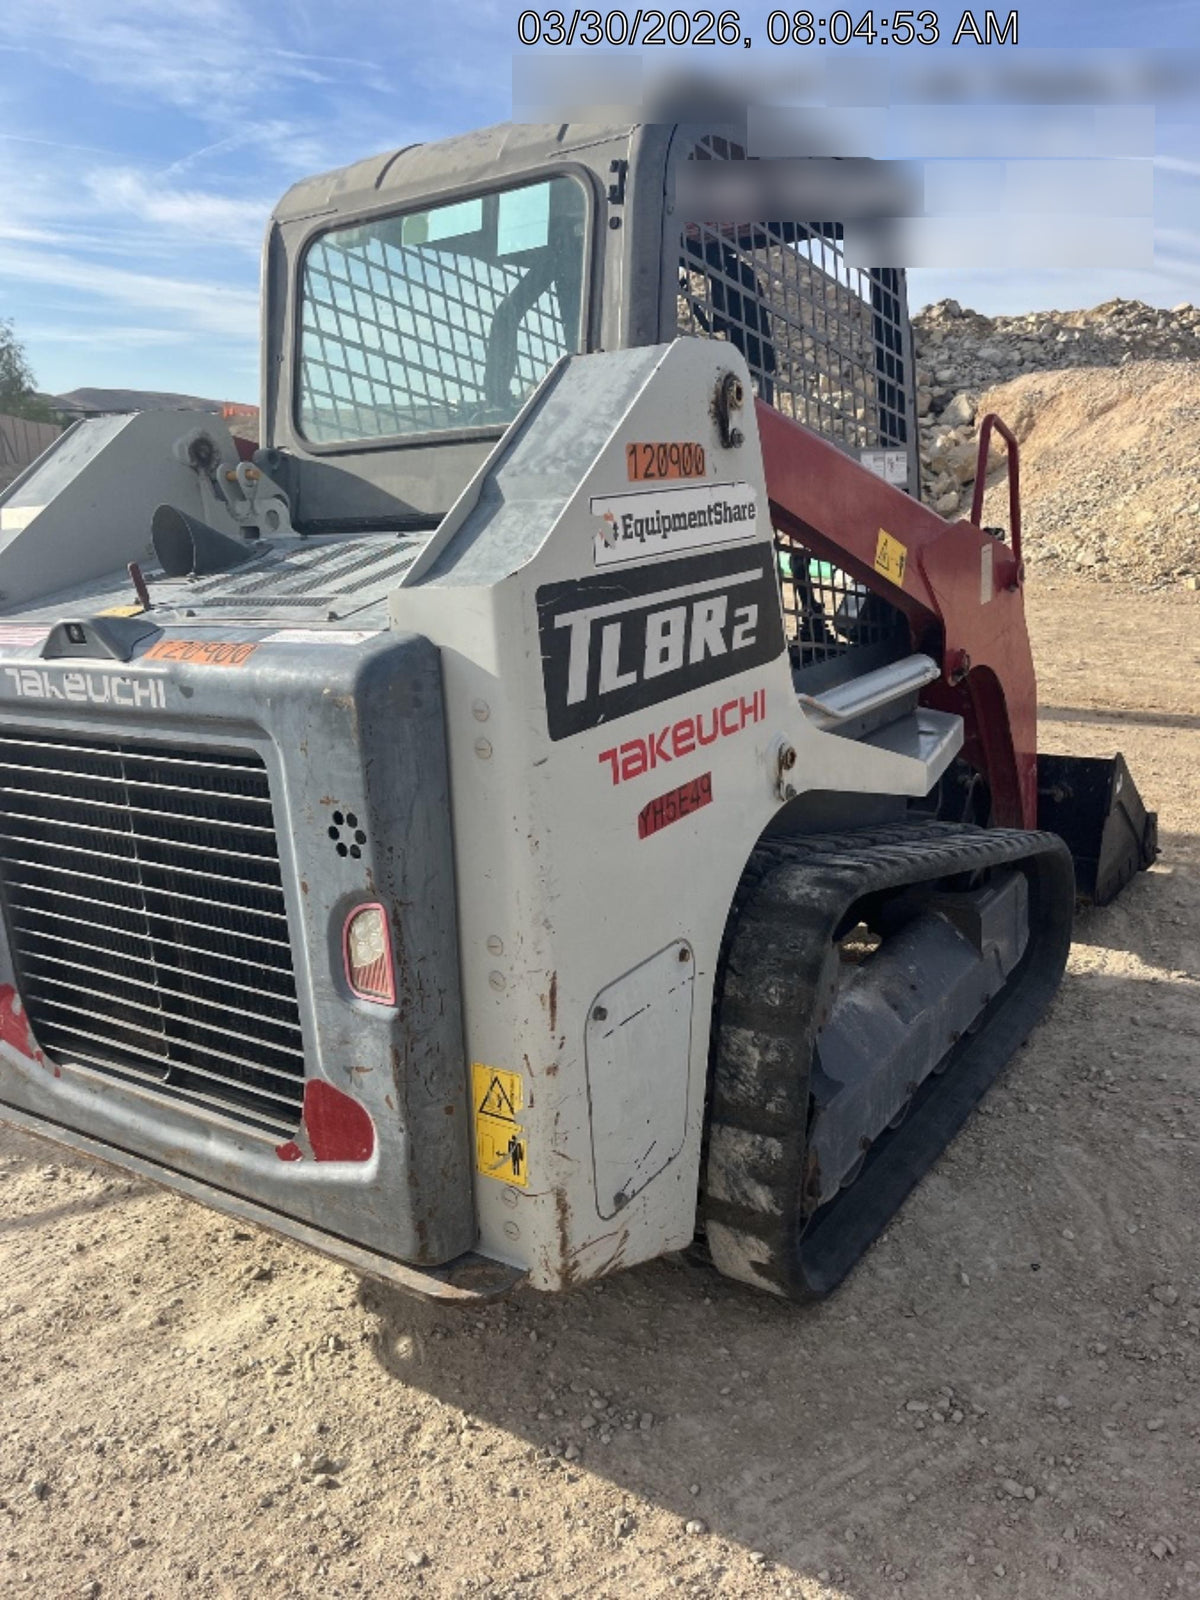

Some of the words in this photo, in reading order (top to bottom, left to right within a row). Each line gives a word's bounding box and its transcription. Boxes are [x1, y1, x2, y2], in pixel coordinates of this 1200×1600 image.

[629, 442, 706, 479] 120900
[621, 501, 756, 543] EquipmentShare
[554, 567, 763, 706] TL8R2
